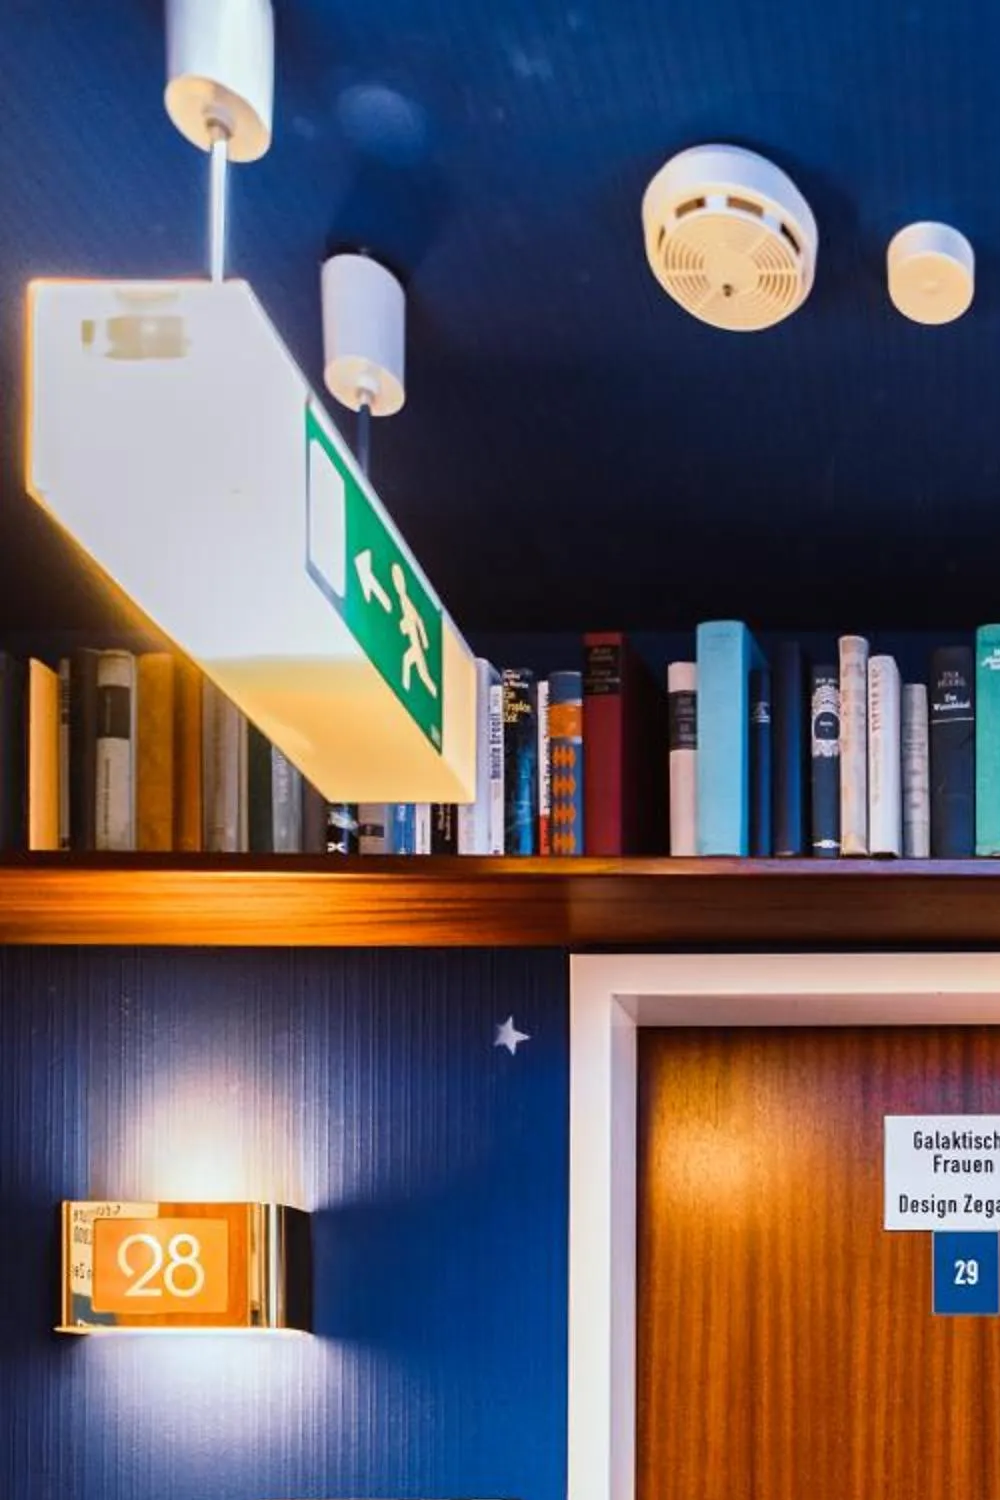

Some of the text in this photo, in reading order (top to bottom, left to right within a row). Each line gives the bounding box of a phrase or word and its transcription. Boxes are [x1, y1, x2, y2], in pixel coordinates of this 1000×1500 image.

[933, 1155, 994, 1173] Frauen
[898, 1194, 957, 1218] Design
[117, 1233, 205, 1297] 28
[953, 1259, 980, 1285] 29
